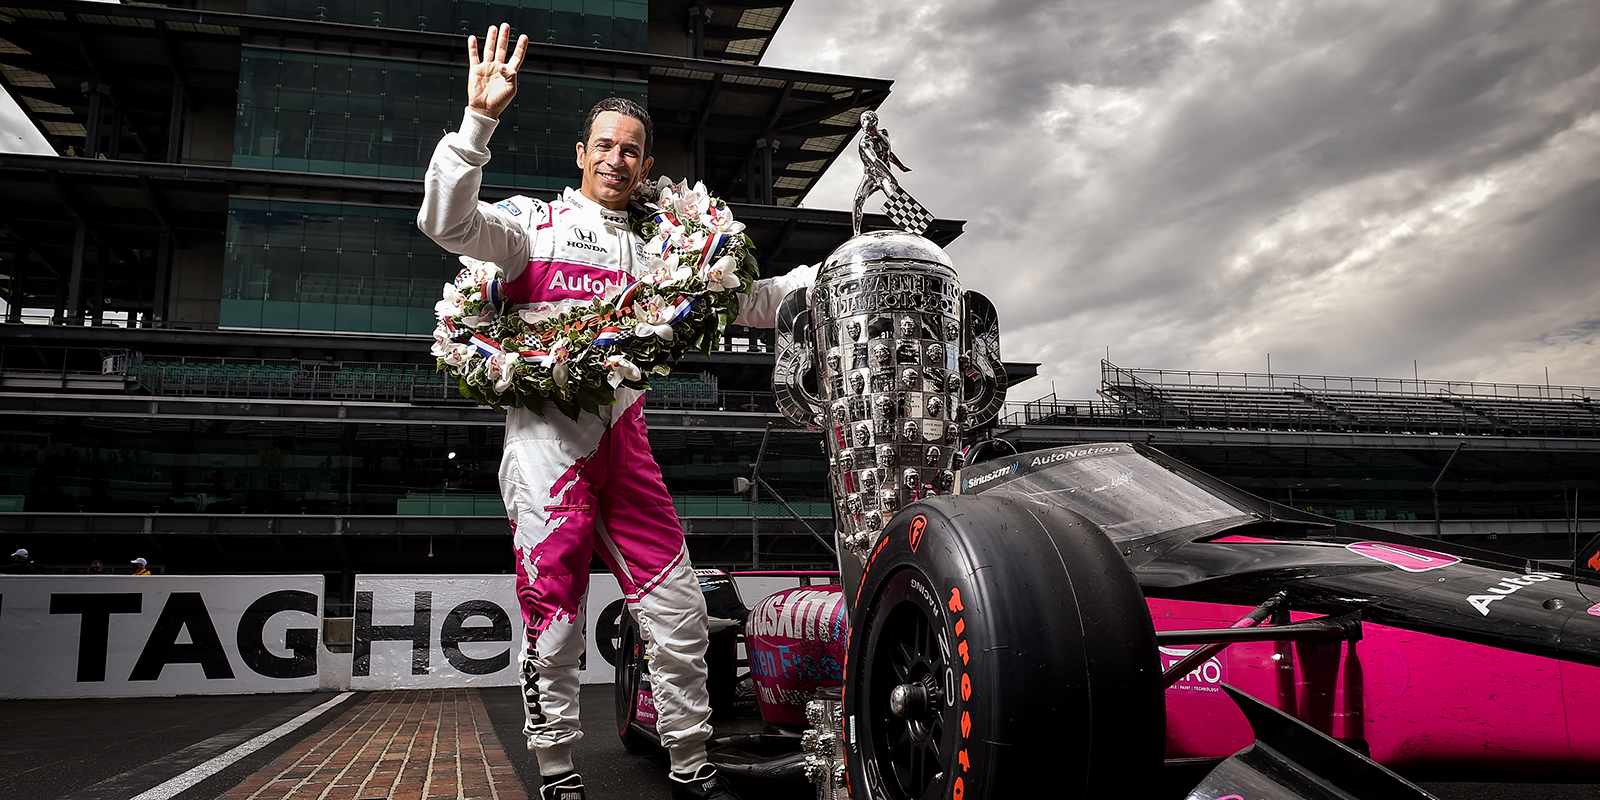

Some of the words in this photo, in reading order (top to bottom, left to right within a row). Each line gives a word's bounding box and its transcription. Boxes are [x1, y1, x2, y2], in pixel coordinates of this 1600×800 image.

[566, 240, 608, 254] HONDA
[1031, 446, 1120, 467] AutoNation
[910, 578, 939, 618] RACING
[50, 589, 319, 682] TAG
[779, 646, 842, 680] Free
